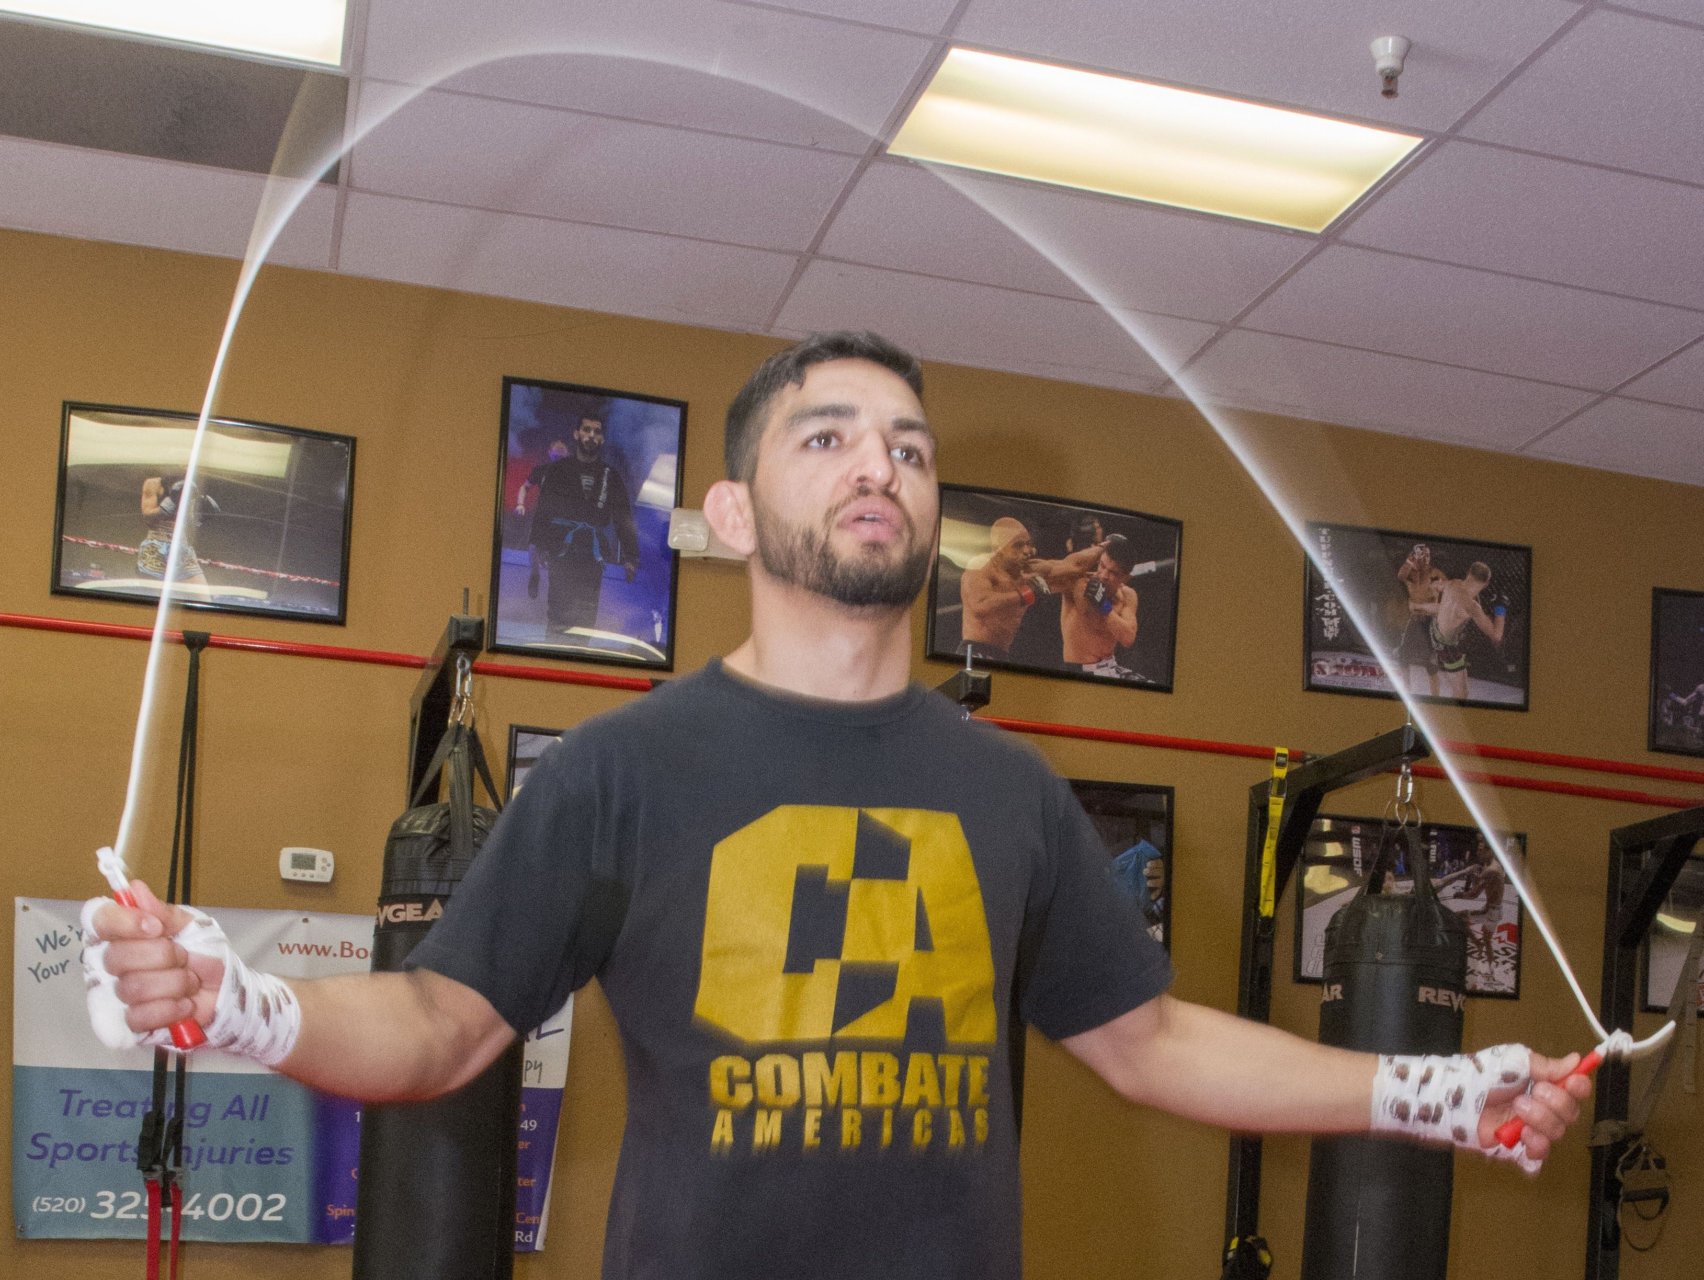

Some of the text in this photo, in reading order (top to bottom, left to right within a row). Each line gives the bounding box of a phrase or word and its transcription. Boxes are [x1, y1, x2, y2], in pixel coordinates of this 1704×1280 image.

[278, 941, 373, 960] www.Bo
[27, 959, 70, 983] Your
[710, 1050, 990, 1107] COMBATE
[58, 1089, 270, 1128] Treatg All
[711, 1108, 989, 1152] AMERICAS
[180, 1138, 294, 1171] njuries
[32, 1195, 86, 1214] (520)
[515, 1230, 534, 1243] Rd
